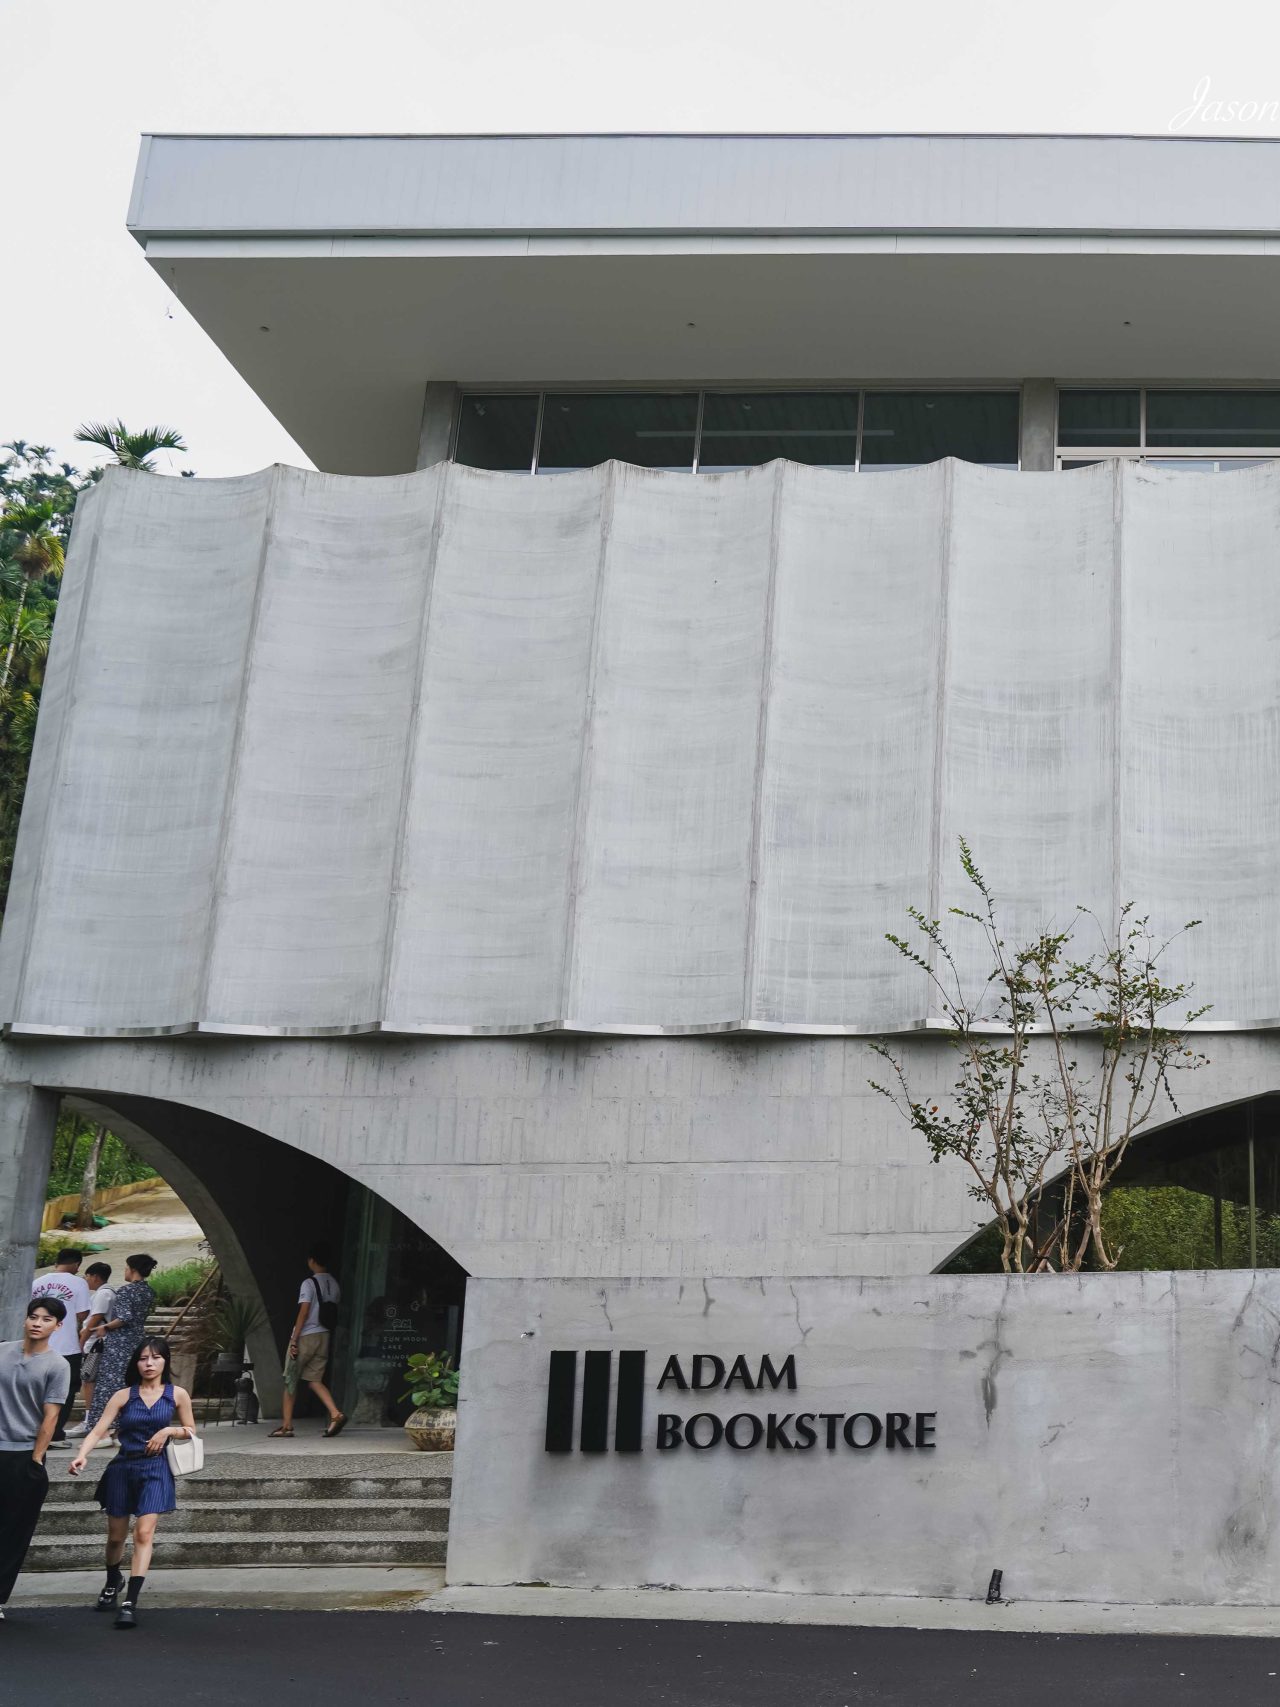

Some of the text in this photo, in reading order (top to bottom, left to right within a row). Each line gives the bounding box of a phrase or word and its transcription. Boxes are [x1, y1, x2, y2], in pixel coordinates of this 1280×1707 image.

[383, 1335, 400, 1343] SUN
[656, 1353, 798, 1390] ADAM
[656, 1410, 938, 1450] BOOKSTORE
